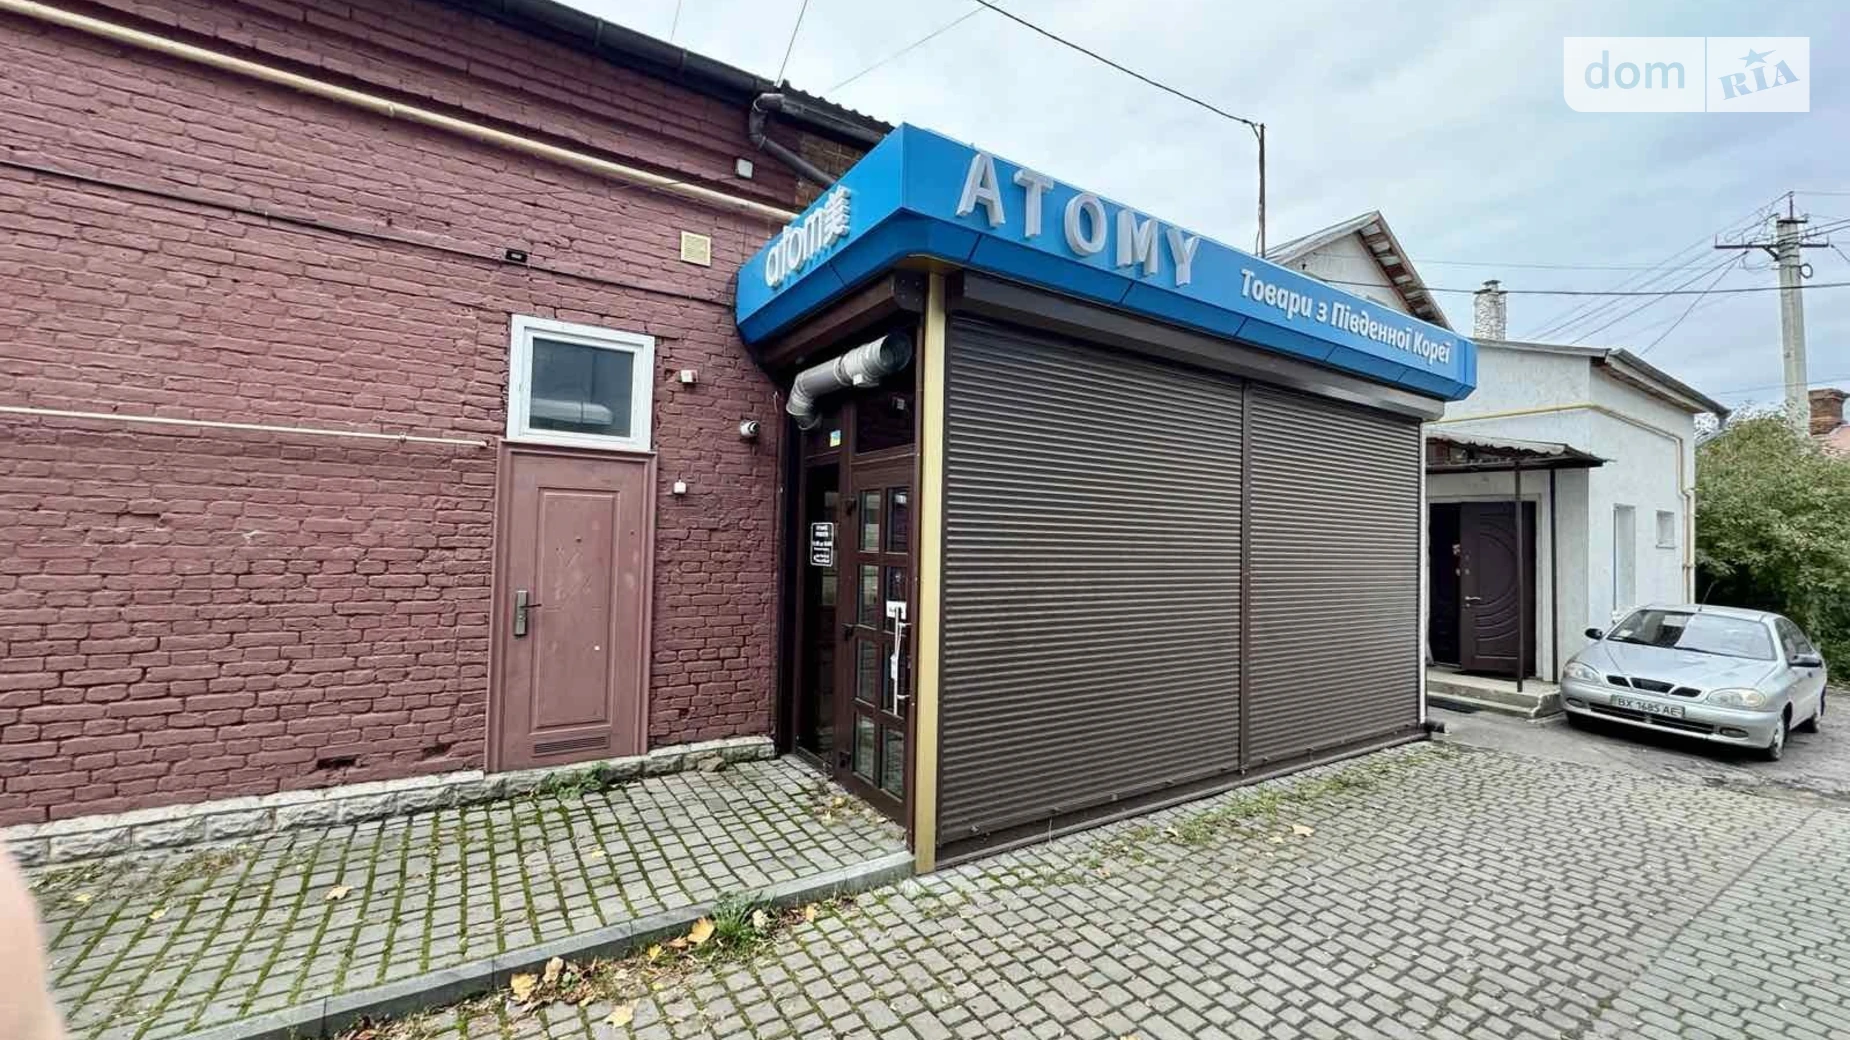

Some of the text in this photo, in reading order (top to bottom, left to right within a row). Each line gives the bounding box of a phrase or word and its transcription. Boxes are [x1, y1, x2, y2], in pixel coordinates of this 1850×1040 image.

[957, 151, 1200, 287] ATOMY
[1241, 269, 1451, 365] Товари з Південної Кореї
